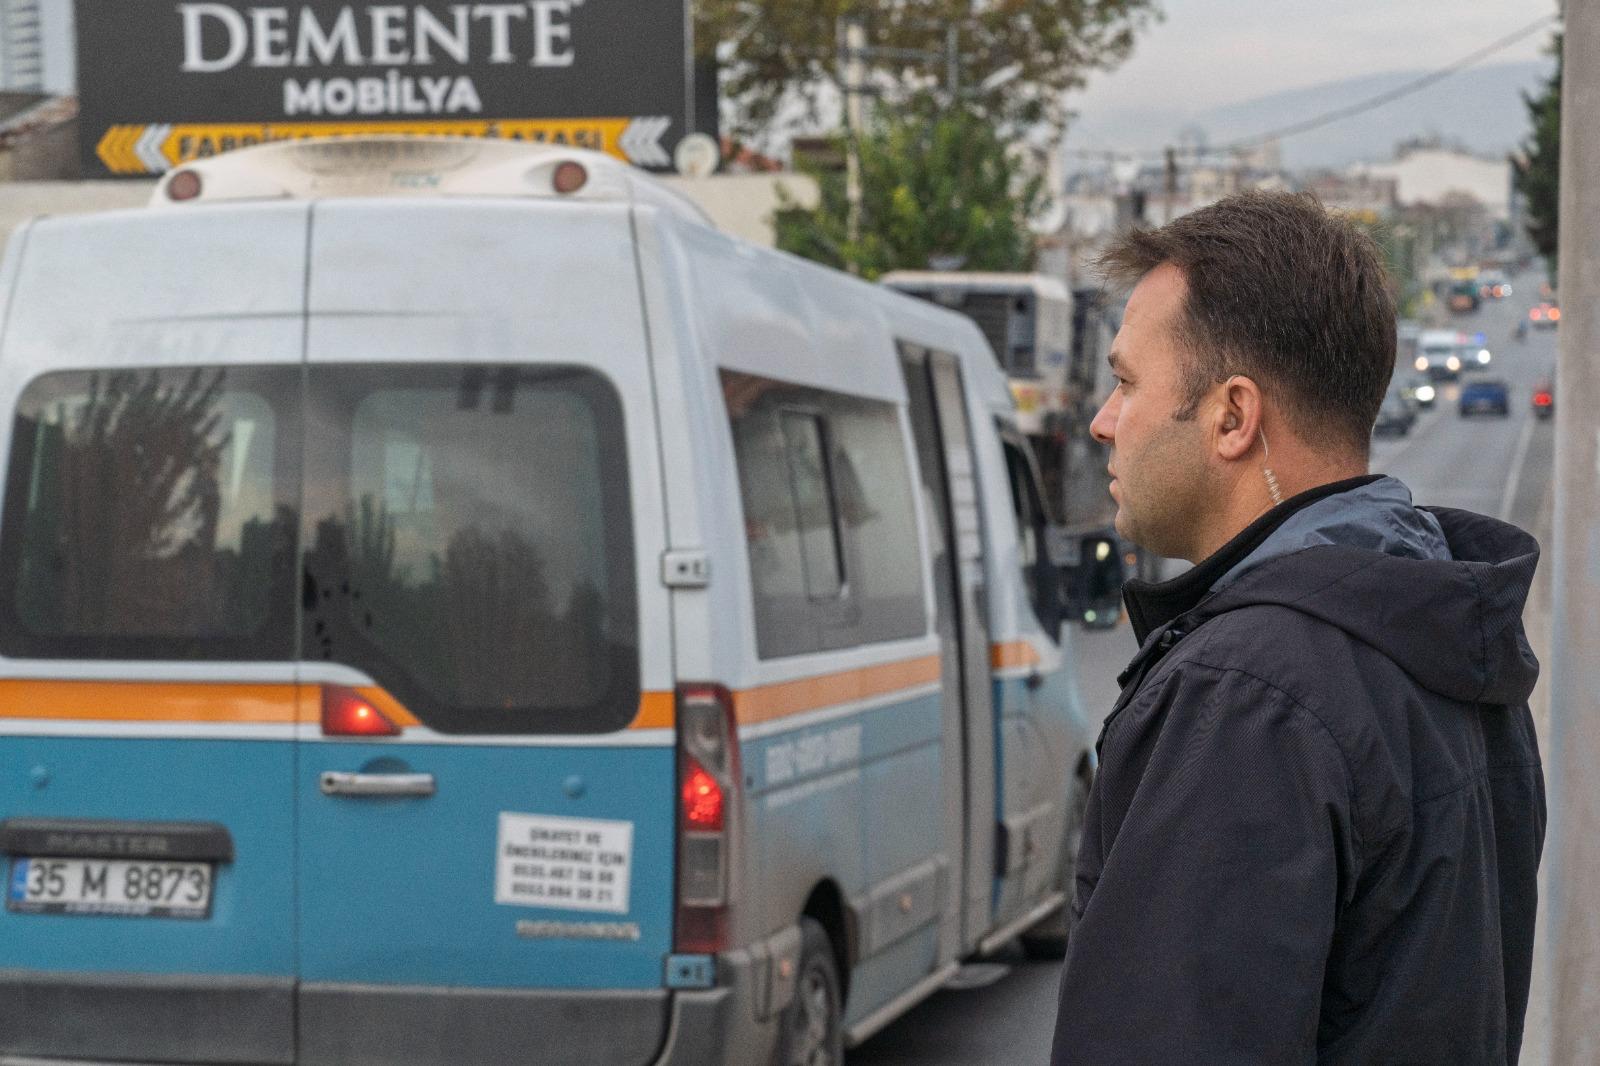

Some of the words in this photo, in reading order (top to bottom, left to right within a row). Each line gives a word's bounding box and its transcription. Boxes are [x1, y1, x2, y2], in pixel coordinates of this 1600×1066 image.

[178, 0, 577, 73] DEMENTE
[283, 68, 482, 116] MOBİLYA
[29, 862, 68, 898] 35
[81, 863, 109, 899] M
[123, 865, 206, 903] 8873
